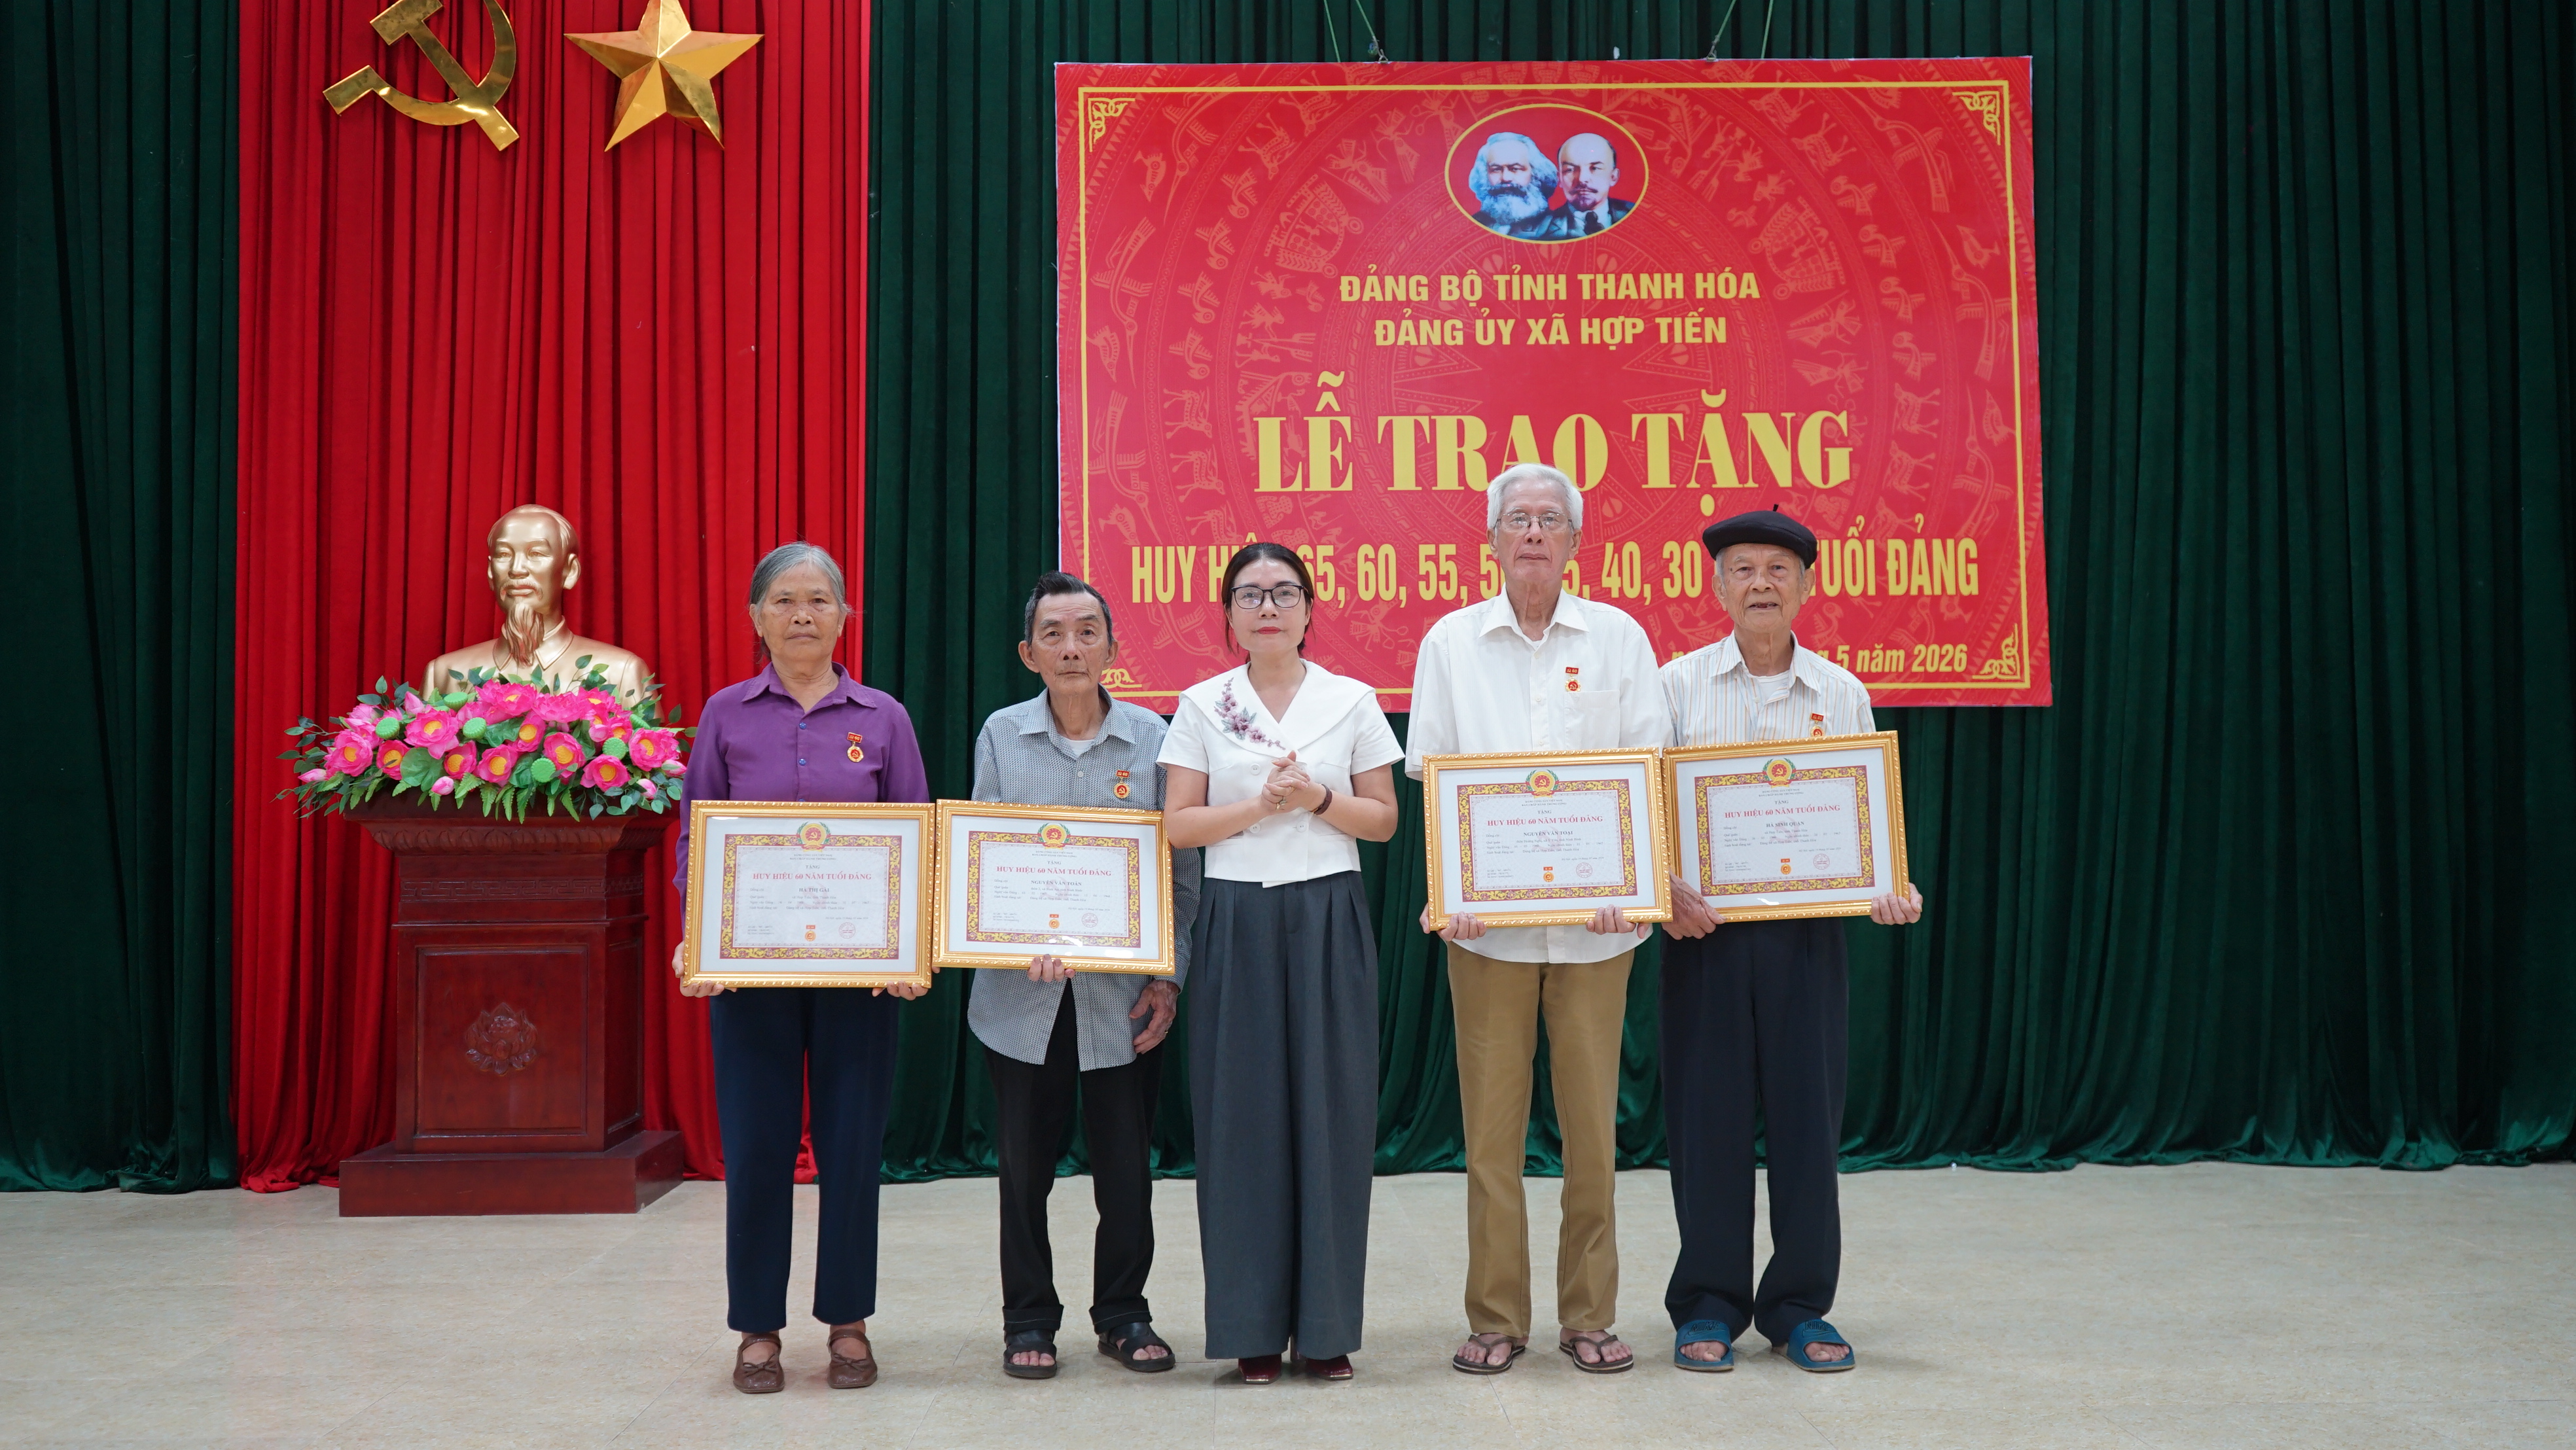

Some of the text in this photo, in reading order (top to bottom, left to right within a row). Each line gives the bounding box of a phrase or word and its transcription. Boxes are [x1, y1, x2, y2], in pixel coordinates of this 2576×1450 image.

[1340, 264, 1761, 307] ĐẢNG BỘ TỈNH THANH HÓA
[1374, 308, 1726, 350] ĐẢNG ỦY XÃ HỢP TIẾN
[1253, 371, 1853, 517] LỄ TRAO TẶNG
[1132, 546, 1196, 603] HUY
[1357, 544, 1406, 608] 60,
[1418, 544, 1467, 607] 55,
[1479, 544, 1506, 600] 5
[1562, 556, 1590, 600] 5,
[1601, 541, 1651, 605] 40,
[1662, 540, 1703, 599] 30
[1809, 515, 1876, 597] UỔI
[1886, 513, 1979, 596] ĐẢNG
[1836, 645, 1850, 670] 5
[1856, 643, 1905, 673] năm
[1911, 644, 1968, 673] 2026
[1507, 817, 1526, 827] HIỆU
[1744, 809, 1764, 818] HIỆU
[773, 872, 793, 881] HIỆU
[1016, 866, 1036, 875] HIỆU
